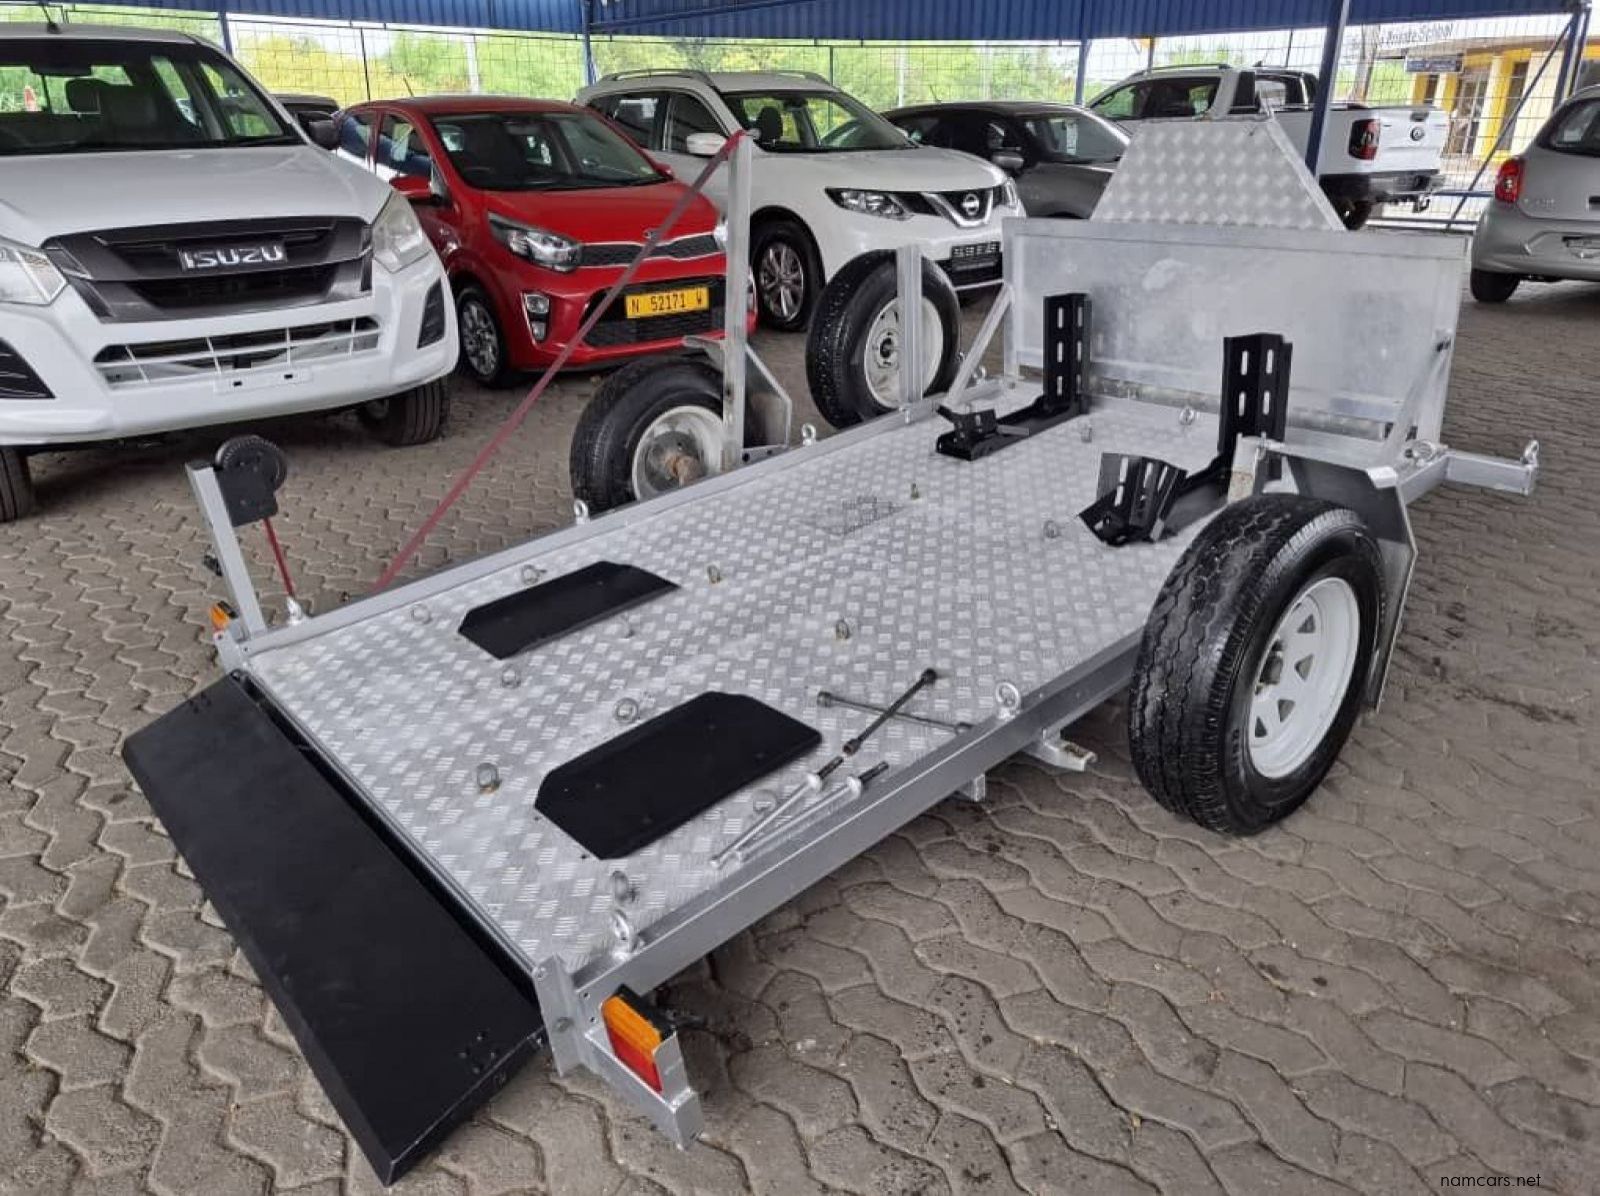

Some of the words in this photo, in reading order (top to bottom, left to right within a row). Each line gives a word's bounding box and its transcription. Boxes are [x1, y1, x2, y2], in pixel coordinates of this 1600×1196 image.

[184, 244, 283, 269] ISUZU
[631, 298, 640, 313] N
[650, 293, 686, 311] 52171
